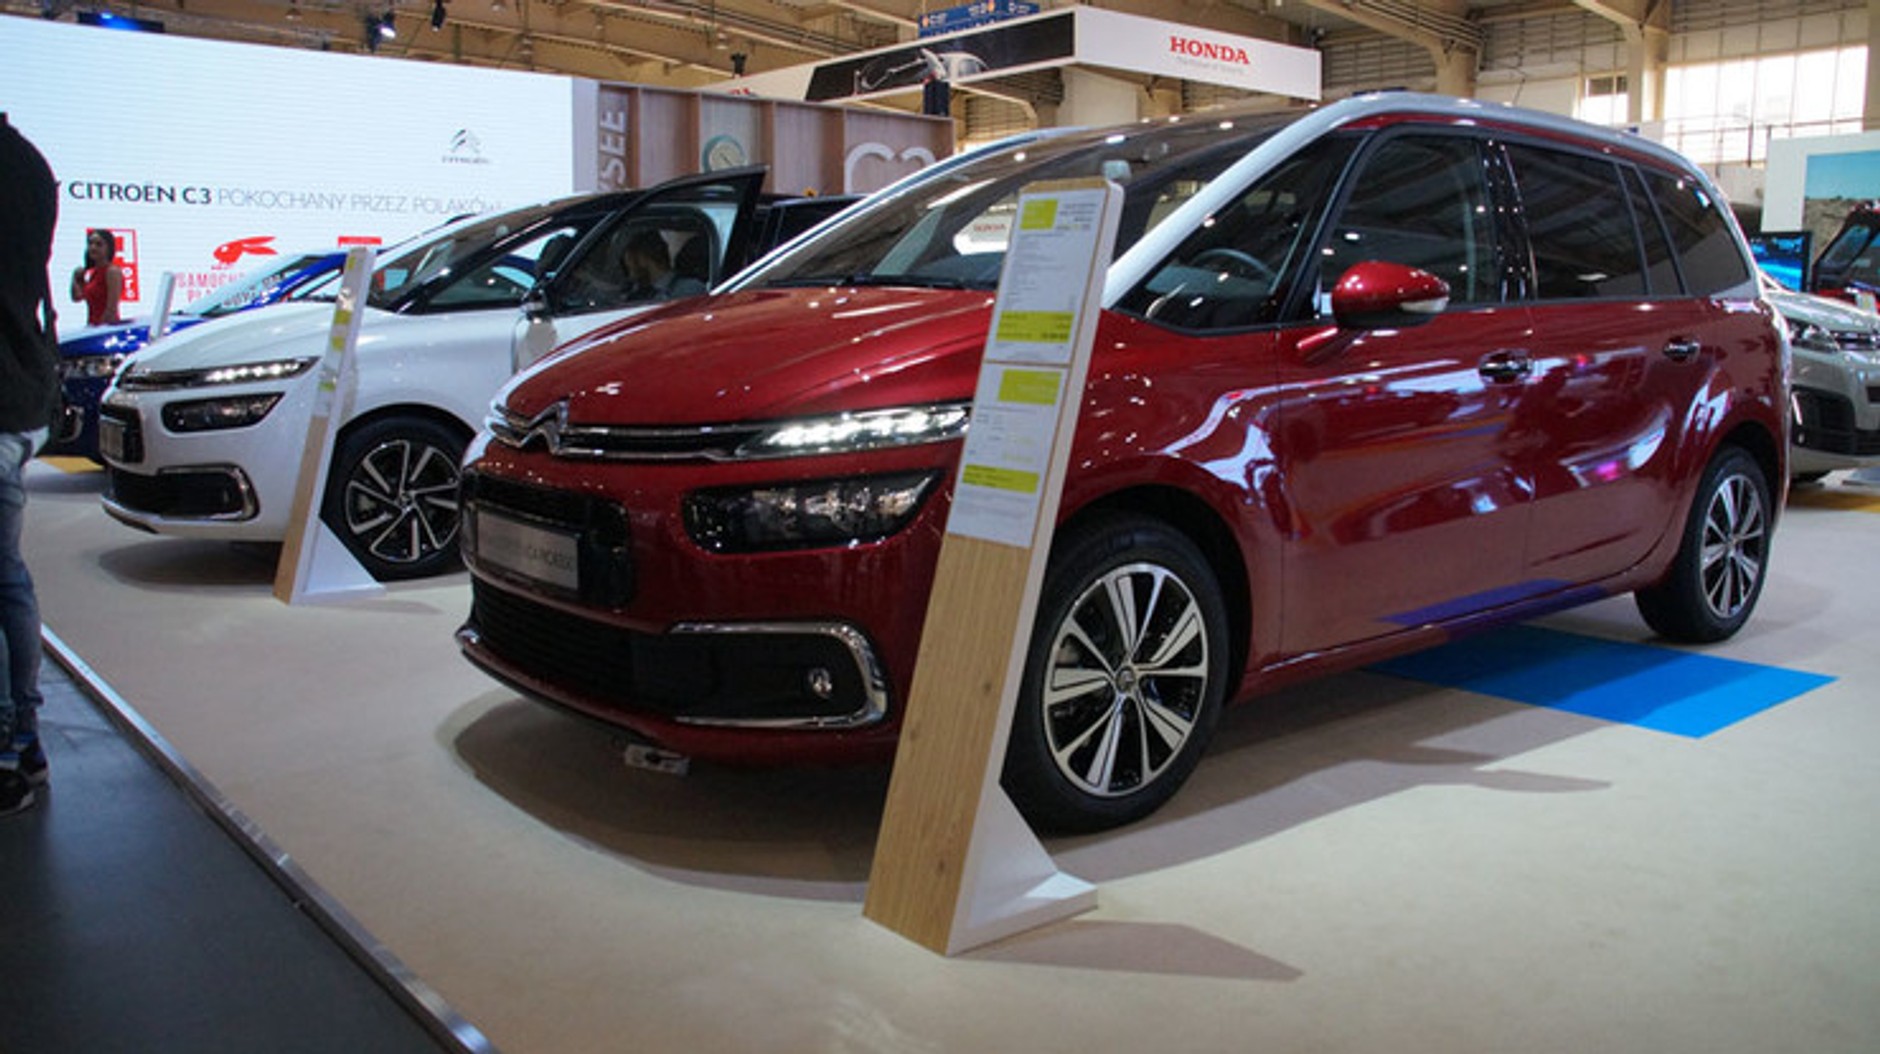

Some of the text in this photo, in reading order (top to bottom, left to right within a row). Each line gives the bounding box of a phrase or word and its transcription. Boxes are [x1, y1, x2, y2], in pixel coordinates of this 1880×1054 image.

[1169, 35, 1250, 65] HONDA
[68, 180, 176, 203] CITROËN
[182, 187, 212, 205] C3
[218, 188, 346, 210] POKOCHANY
[351, 196, 407, 213] PRZEZ
